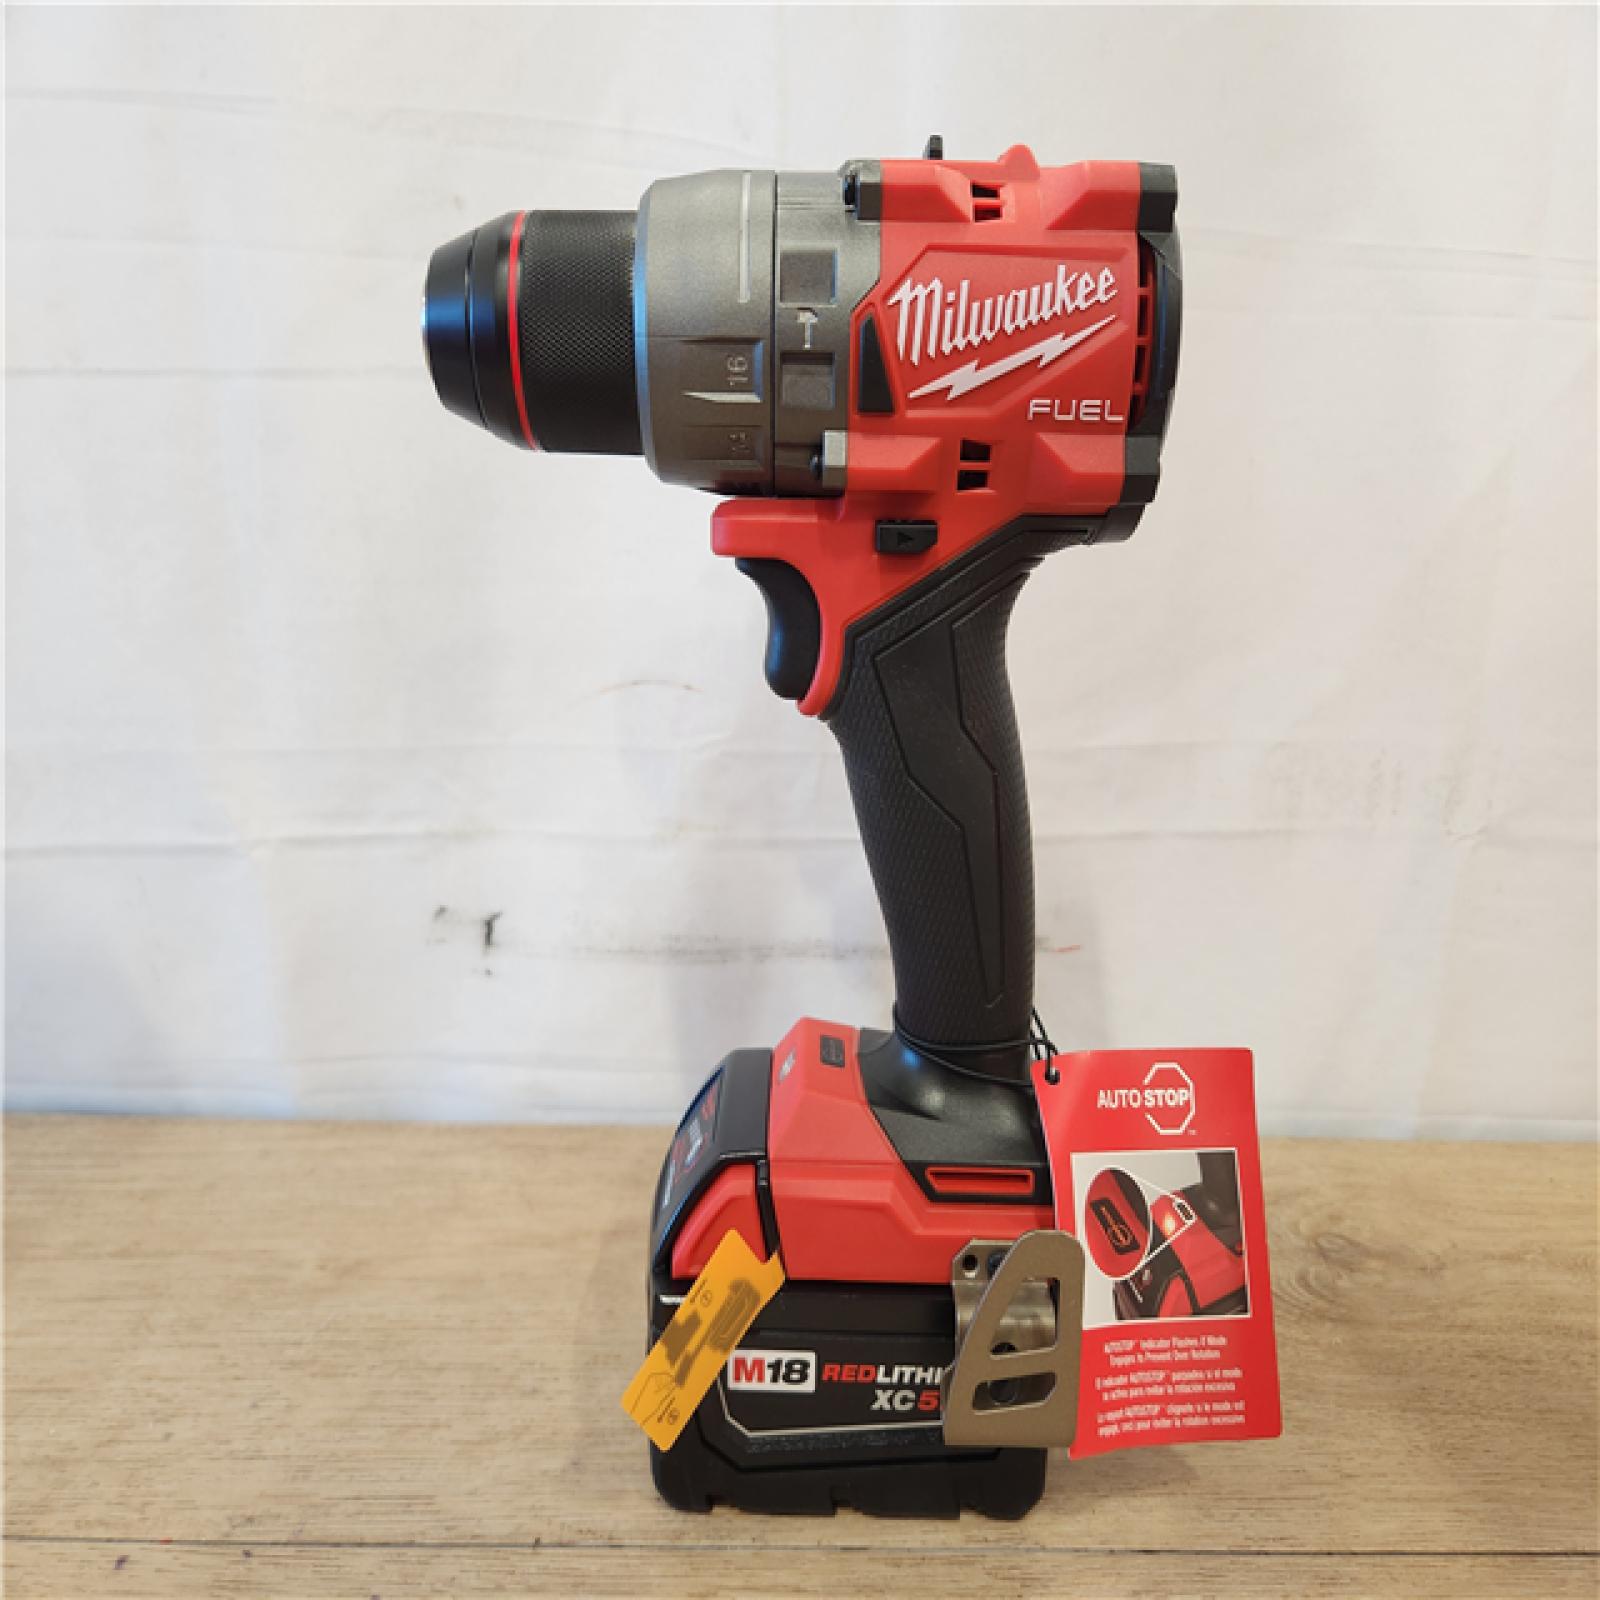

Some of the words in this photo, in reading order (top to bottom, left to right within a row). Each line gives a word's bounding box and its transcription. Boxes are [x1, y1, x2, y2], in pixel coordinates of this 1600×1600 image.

[888, 264, 1118, 366] Milwaukee
[727, 354, 748, 386] 16
[1027, 399, 1124, 421] FUEL
[732, 1356, 811, 1385] M18
[822, 1362, 943, 1385] REDLITHI
[870, 1388, 941, 1412] XC5
